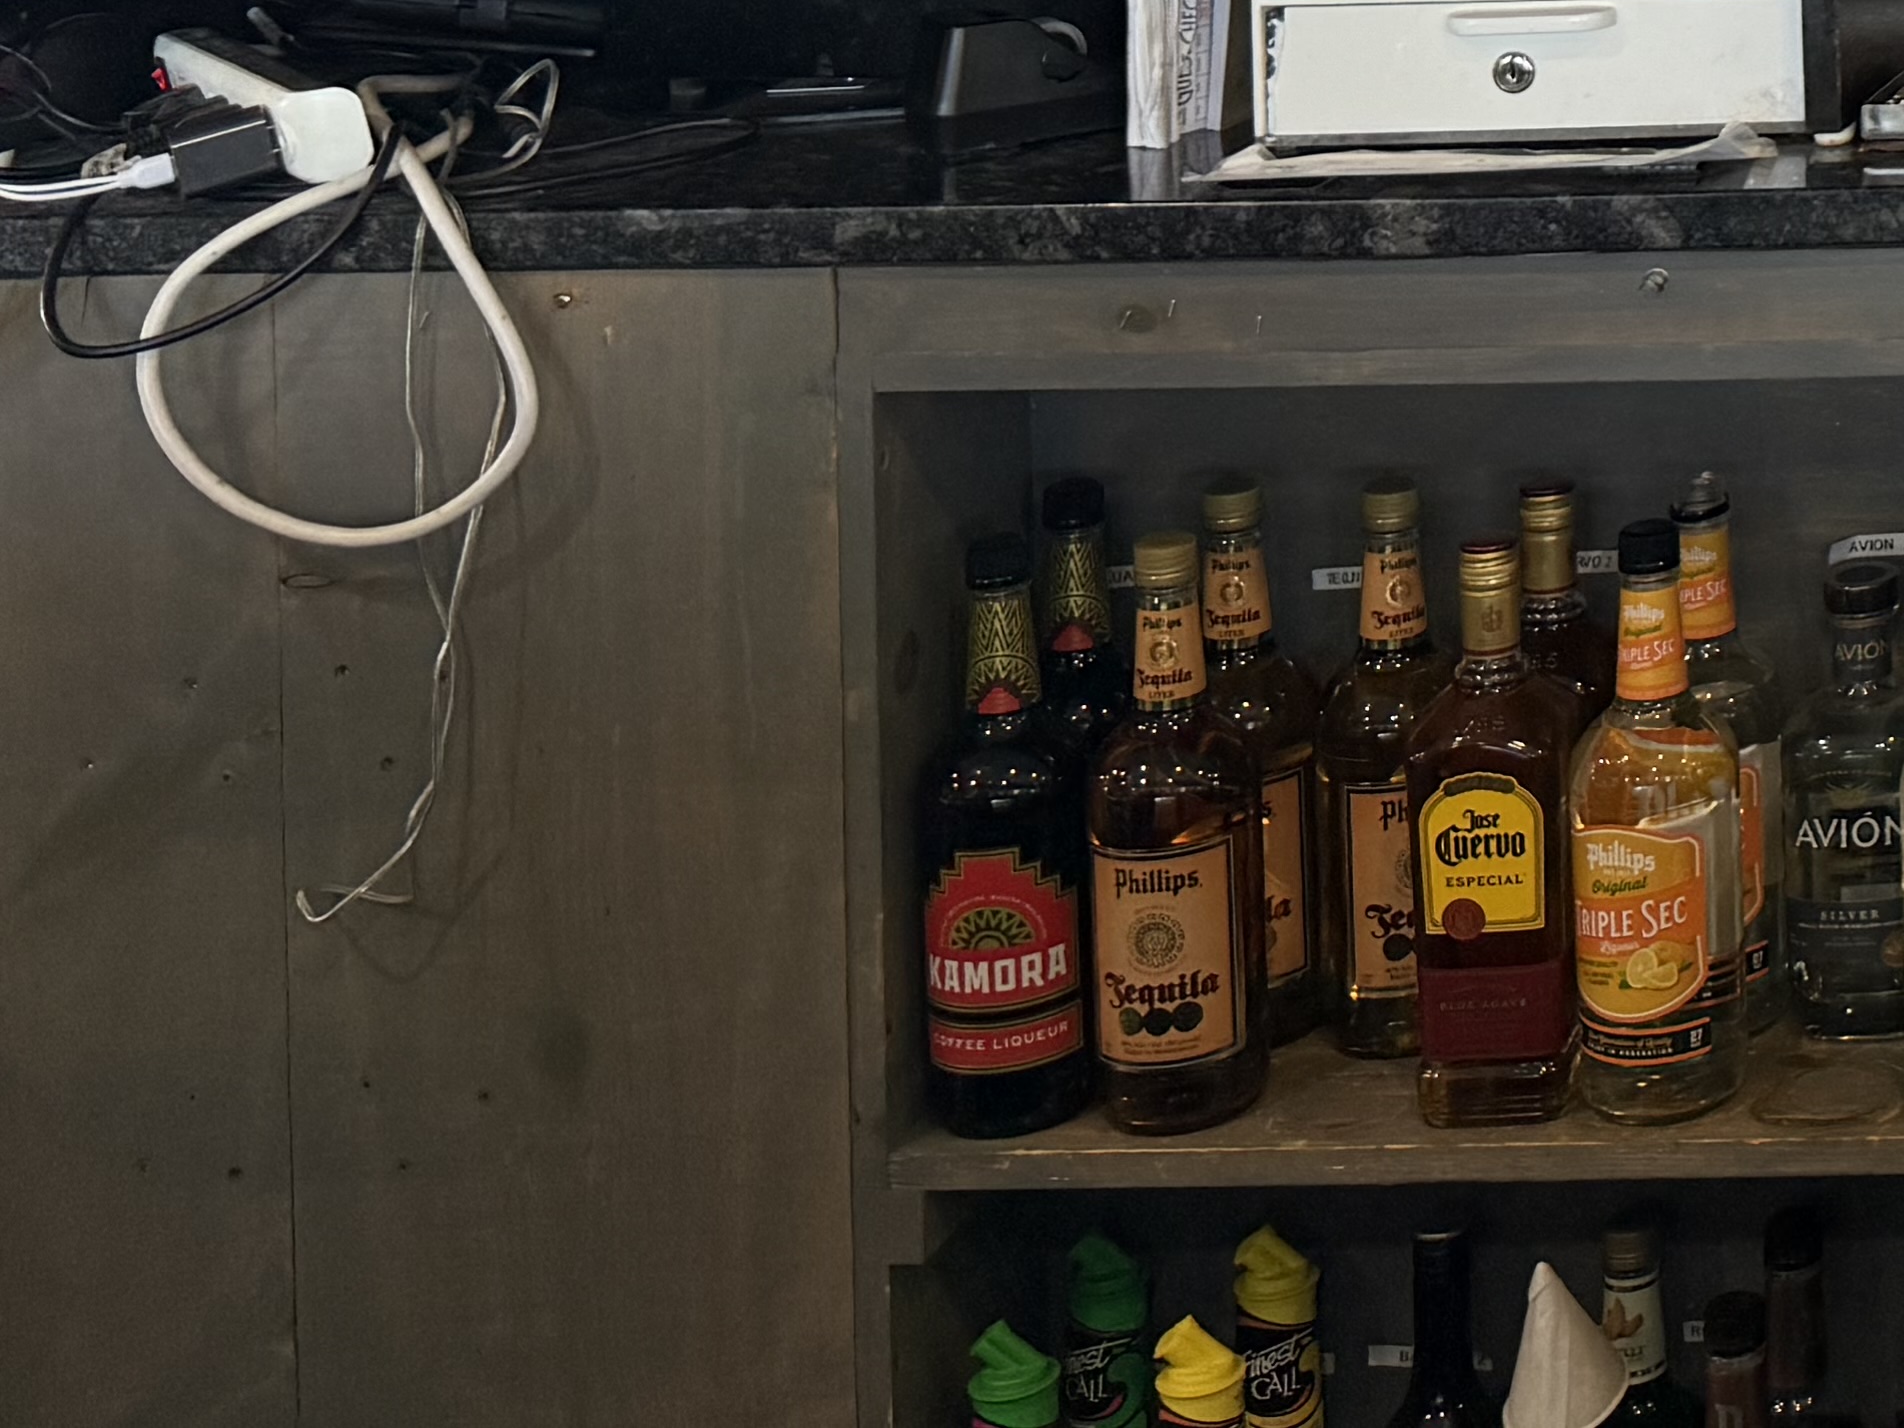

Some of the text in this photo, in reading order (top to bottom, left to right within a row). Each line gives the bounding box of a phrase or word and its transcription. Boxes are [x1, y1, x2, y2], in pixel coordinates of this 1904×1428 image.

[1848, 537, 1894, 554] AVION
[1463, 809, 1500, 832] Jose
[1436, 825, 1527, 866] Cuervo
[1587, 842, 1655, 873] Phillips
[1115, 867, 1203, 898] Phillips
[1446, 874, 1524, 887] ESPECIAL
[1592, 876, 1647, 898] Original
[1575, 902, 1636, 939] TRIPLE
[1820, 908, 1880, 922] SILVER
[929, 942, 1067, 992] KAMORA
[1106, 971, 1220, 1010] Tequila
[993, 1021, 1068, 1050] LIQUEUR
[1251, 1365, 1300, 1400] CALL
